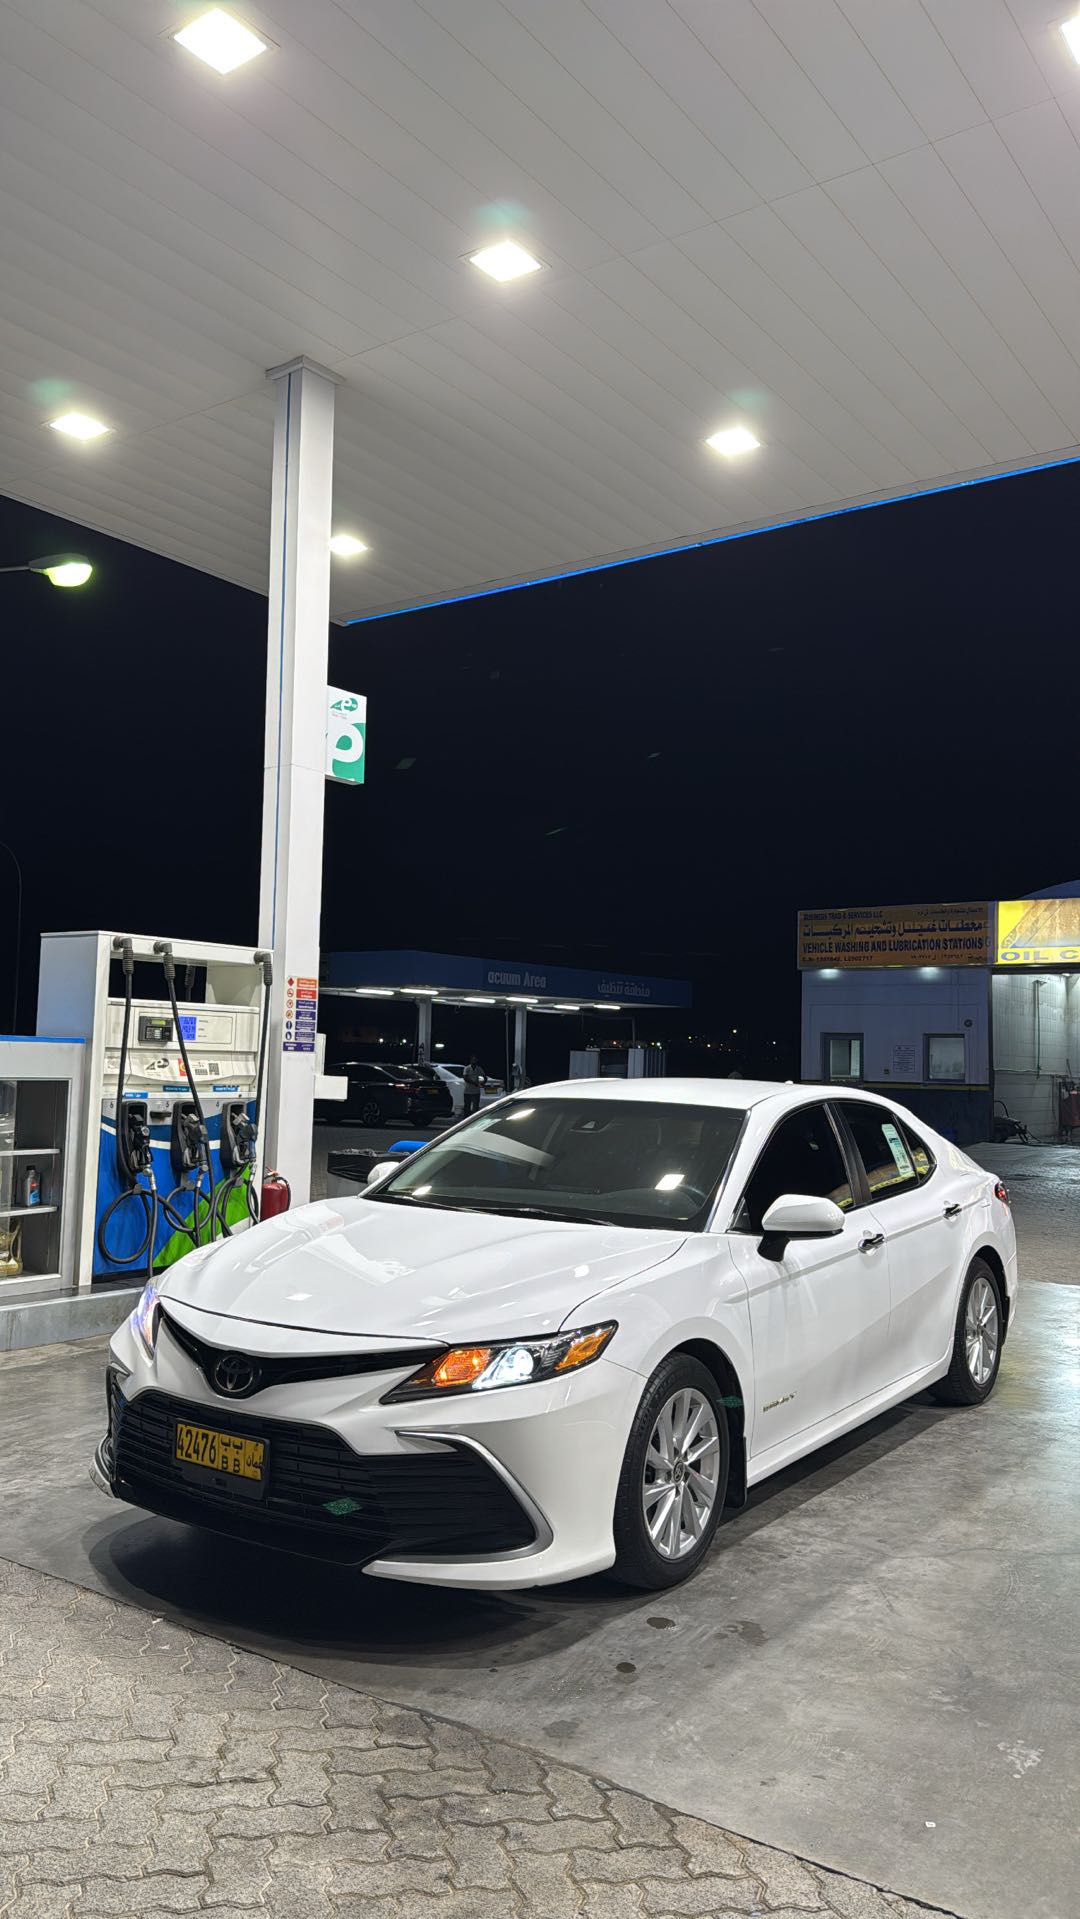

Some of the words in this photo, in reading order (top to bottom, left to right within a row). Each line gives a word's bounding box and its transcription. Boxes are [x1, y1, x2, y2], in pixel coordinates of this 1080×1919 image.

[803, 942, 833, 954] VEHICLE
[835, 941, 870, 954] WASHING
[871, 940, 887, 952] AND
[889, 938, 941, 951] LUBRICATION
[942, 936, 984, 950] STATIONS
[1001, 951, 1049, 961] OIL
[487, 971, 521, 986] acuum
[523, 971, 547, 988] Area
[177, 1426, 216, 1465] 42476
